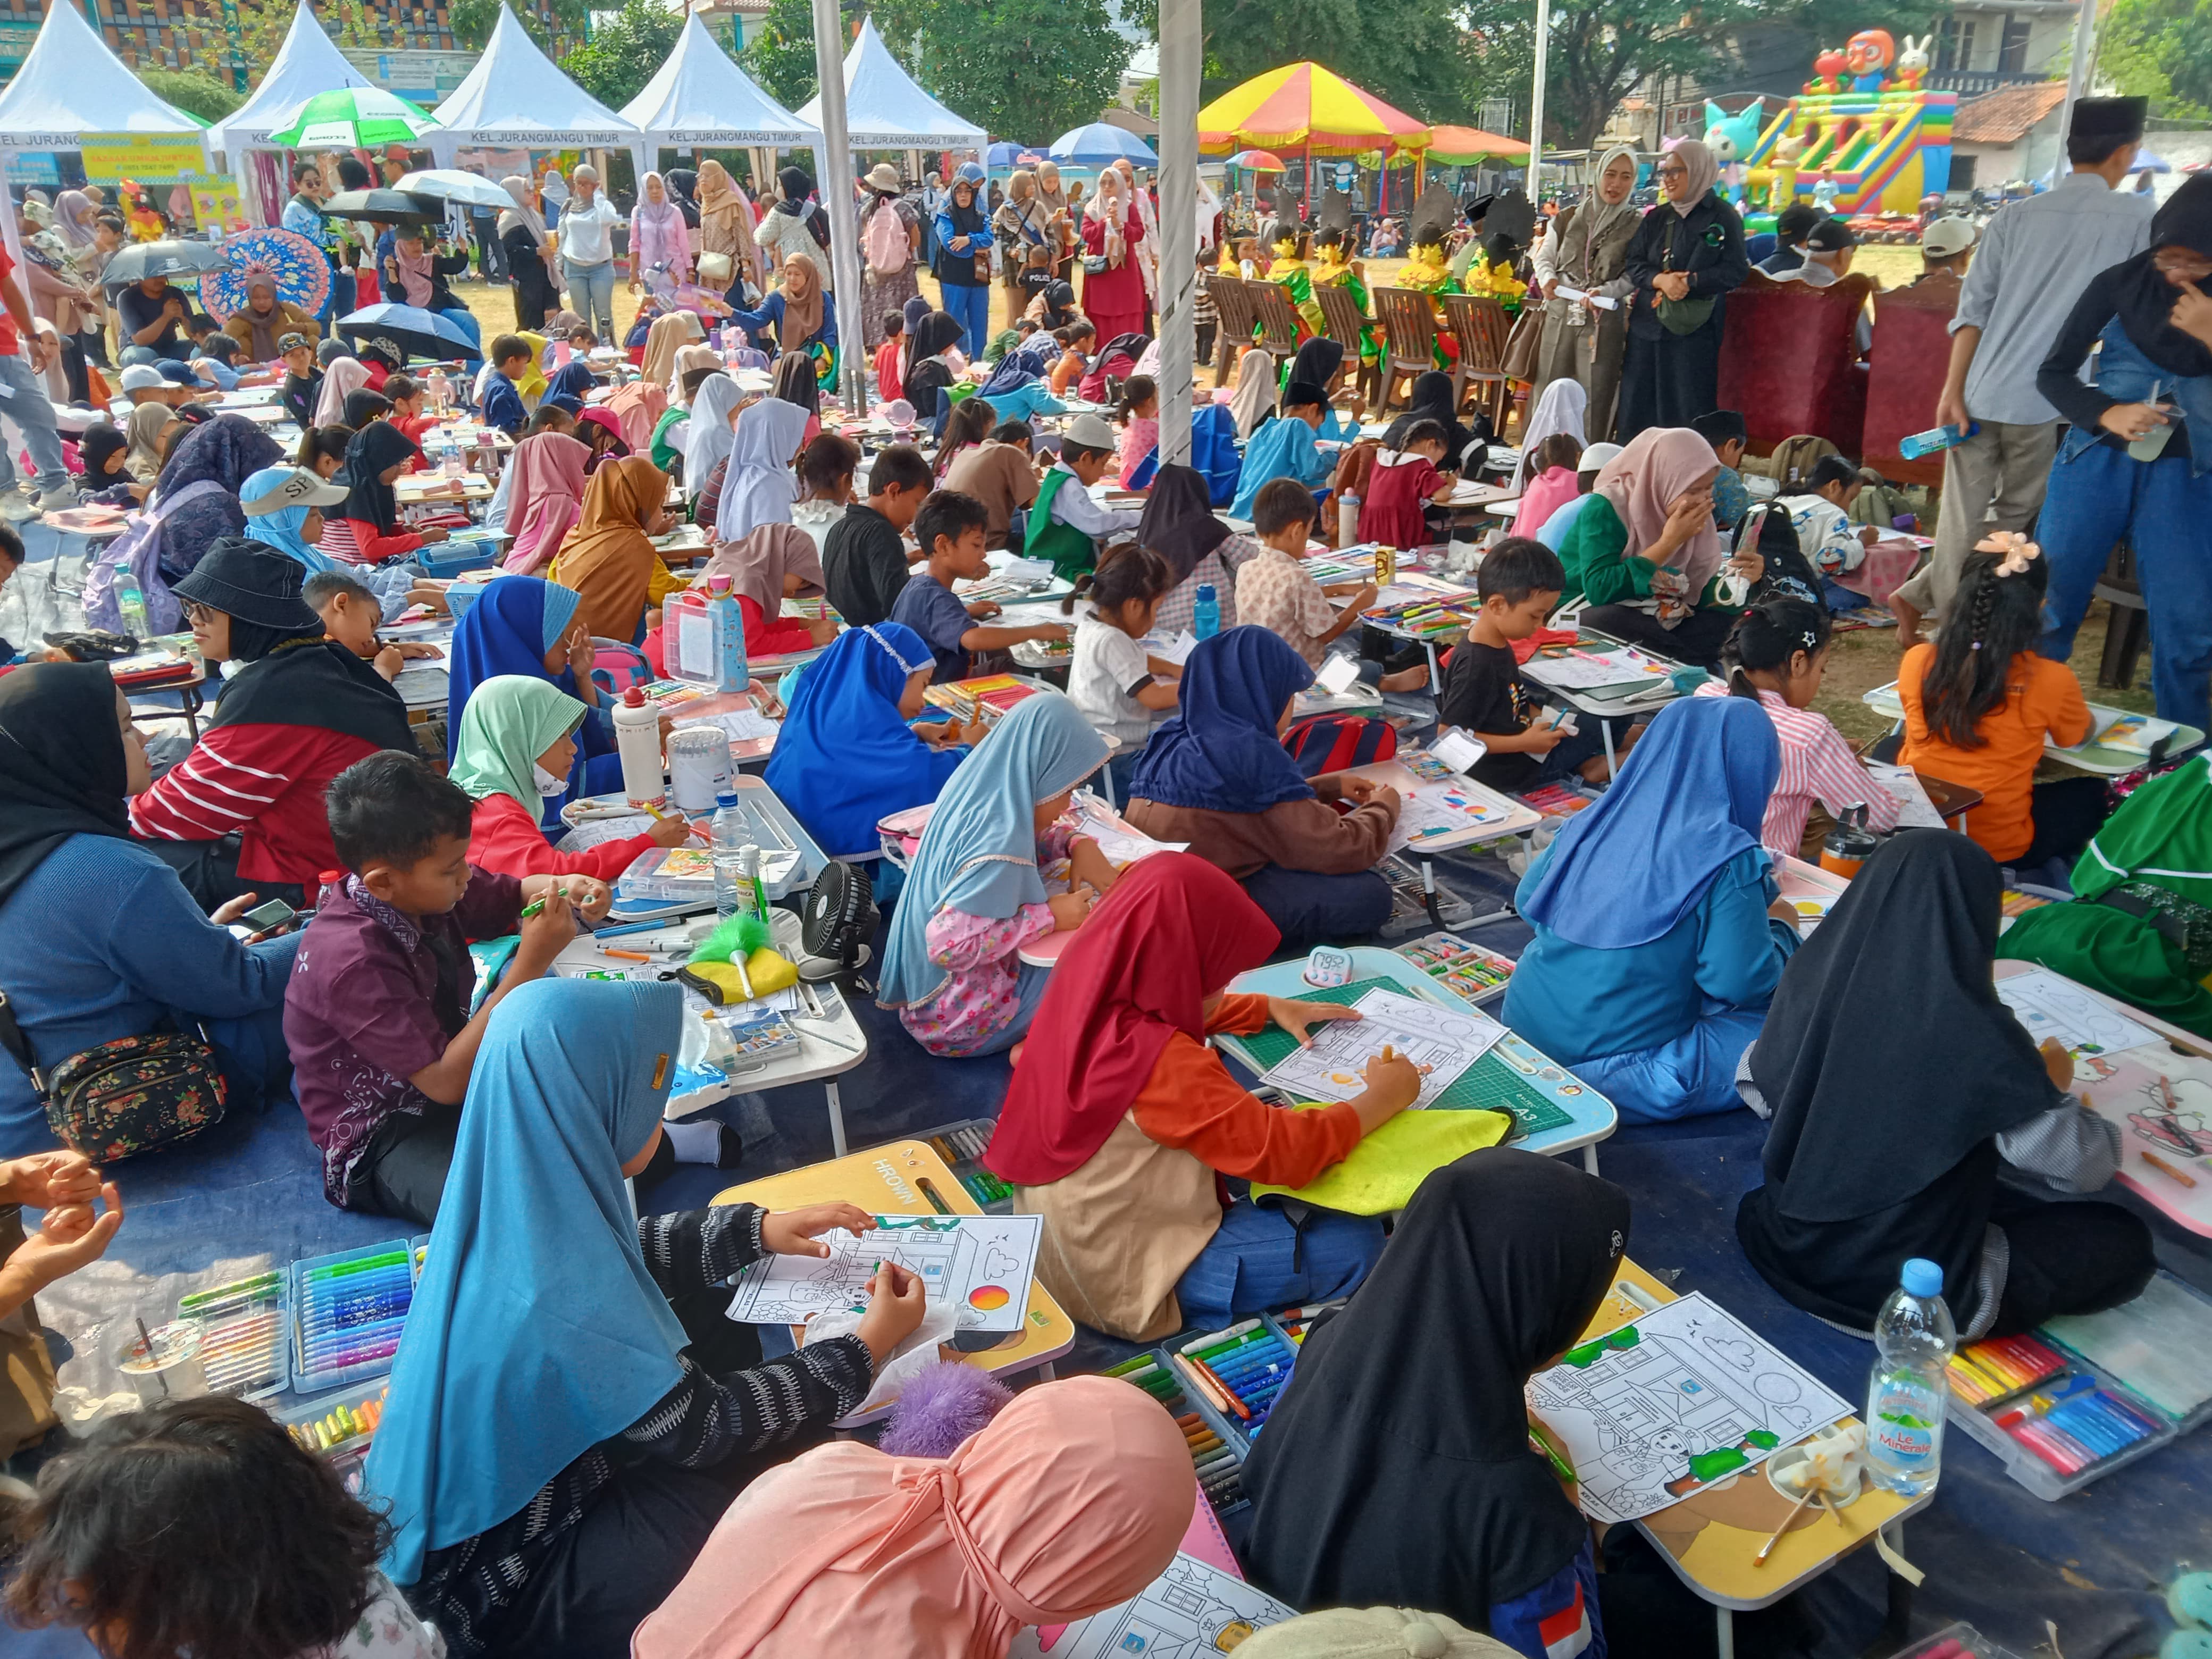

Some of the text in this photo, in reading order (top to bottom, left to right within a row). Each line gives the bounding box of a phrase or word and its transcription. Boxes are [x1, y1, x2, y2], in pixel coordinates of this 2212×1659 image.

[498, 132, 584, 143] JURANGMANGU
[586, 133, 619, 143] TIMUR
[693, 132, 770, 141] JURANGMANGU
[869, 135, 941, 145] JURANGMANGU
[943, 136, 969, 145] TIMUR
[1512, 1108, 1538, 1121] A3
[1879, 1433, 1932, 1453] Minerale
[1898, 1432, 1913, 1444] Le
